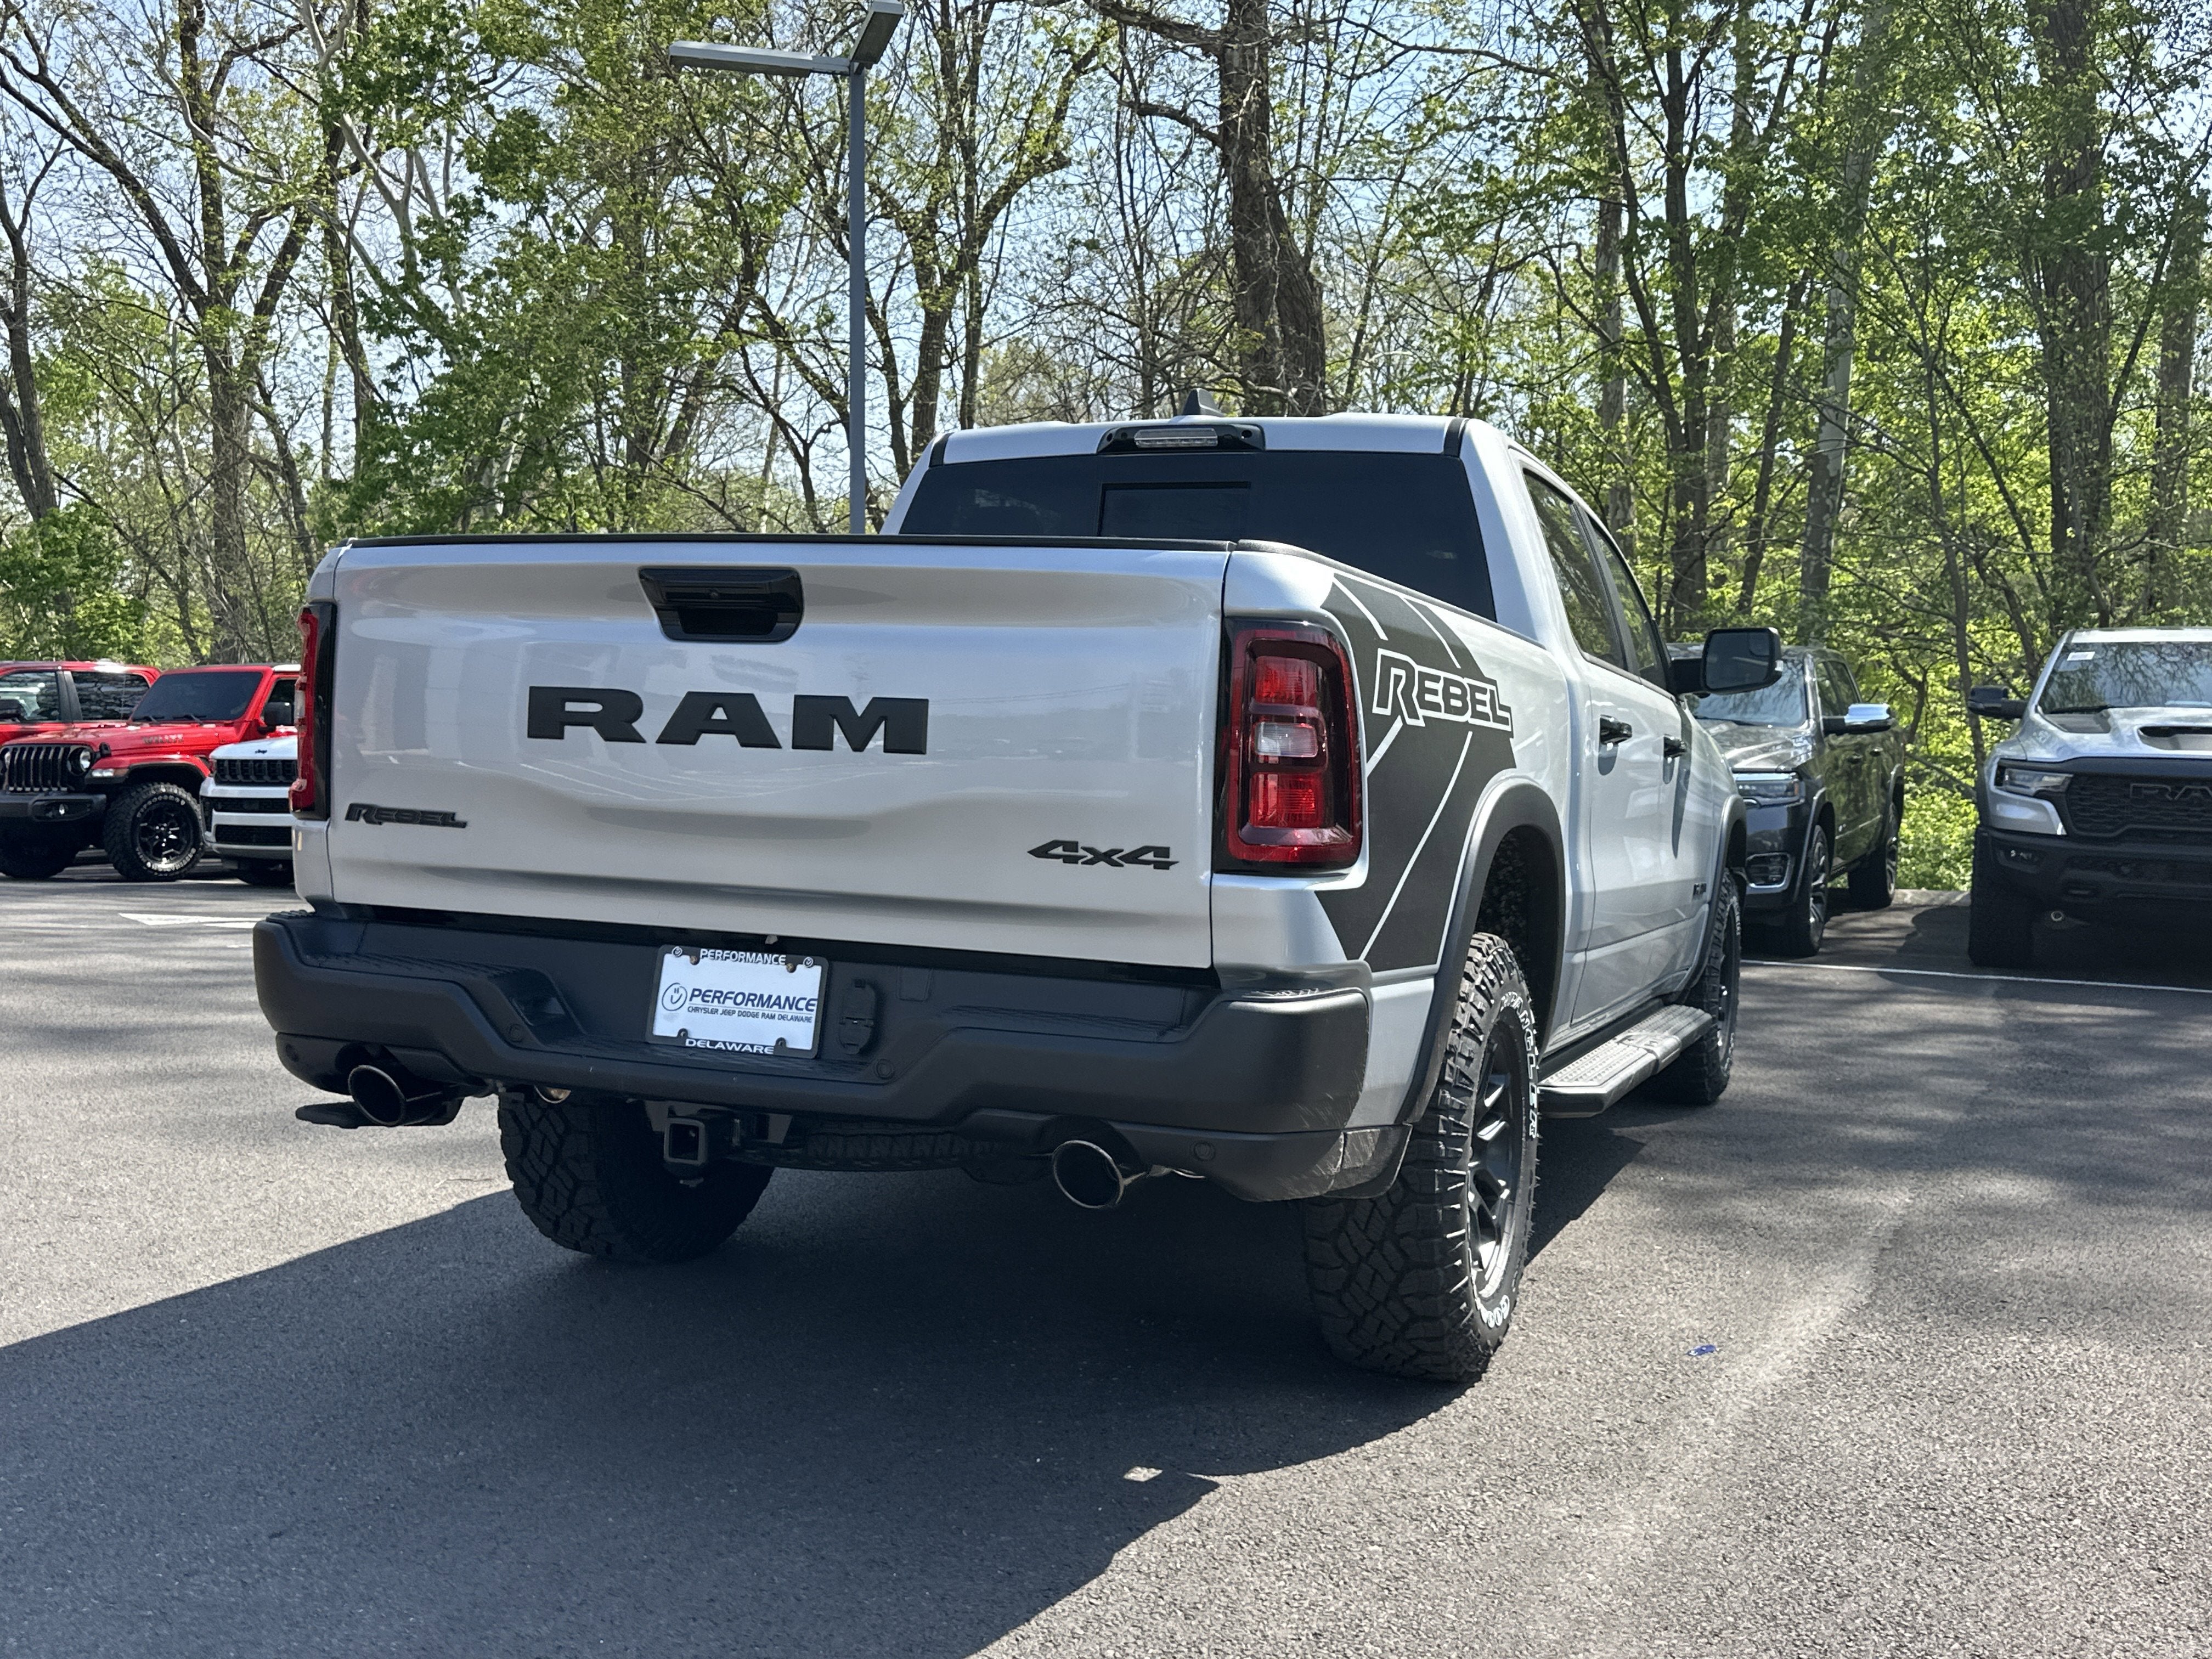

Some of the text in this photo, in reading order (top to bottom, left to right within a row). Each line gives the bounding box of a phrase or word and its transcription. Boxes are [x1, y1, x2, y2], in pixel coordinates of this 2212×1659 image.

[1372, 648, 1512, 731] REBEL
[527, 686, 929, 755] RAM
[2130, 782, 2212, 801] RA
[345, 803, 468, 829] REBEL
[699, 949, 786, 965] PERFORMANCE
[689, 988, 818, 1012] PERFORMANCE
[687, 1006, 719, 1015] CHRYSLER
[737, 1010, 760, 1019] DODGE
[777, 1013, 812, 1023] DELAWARE
[686, 1038, 774, 1054] DELAWARE
